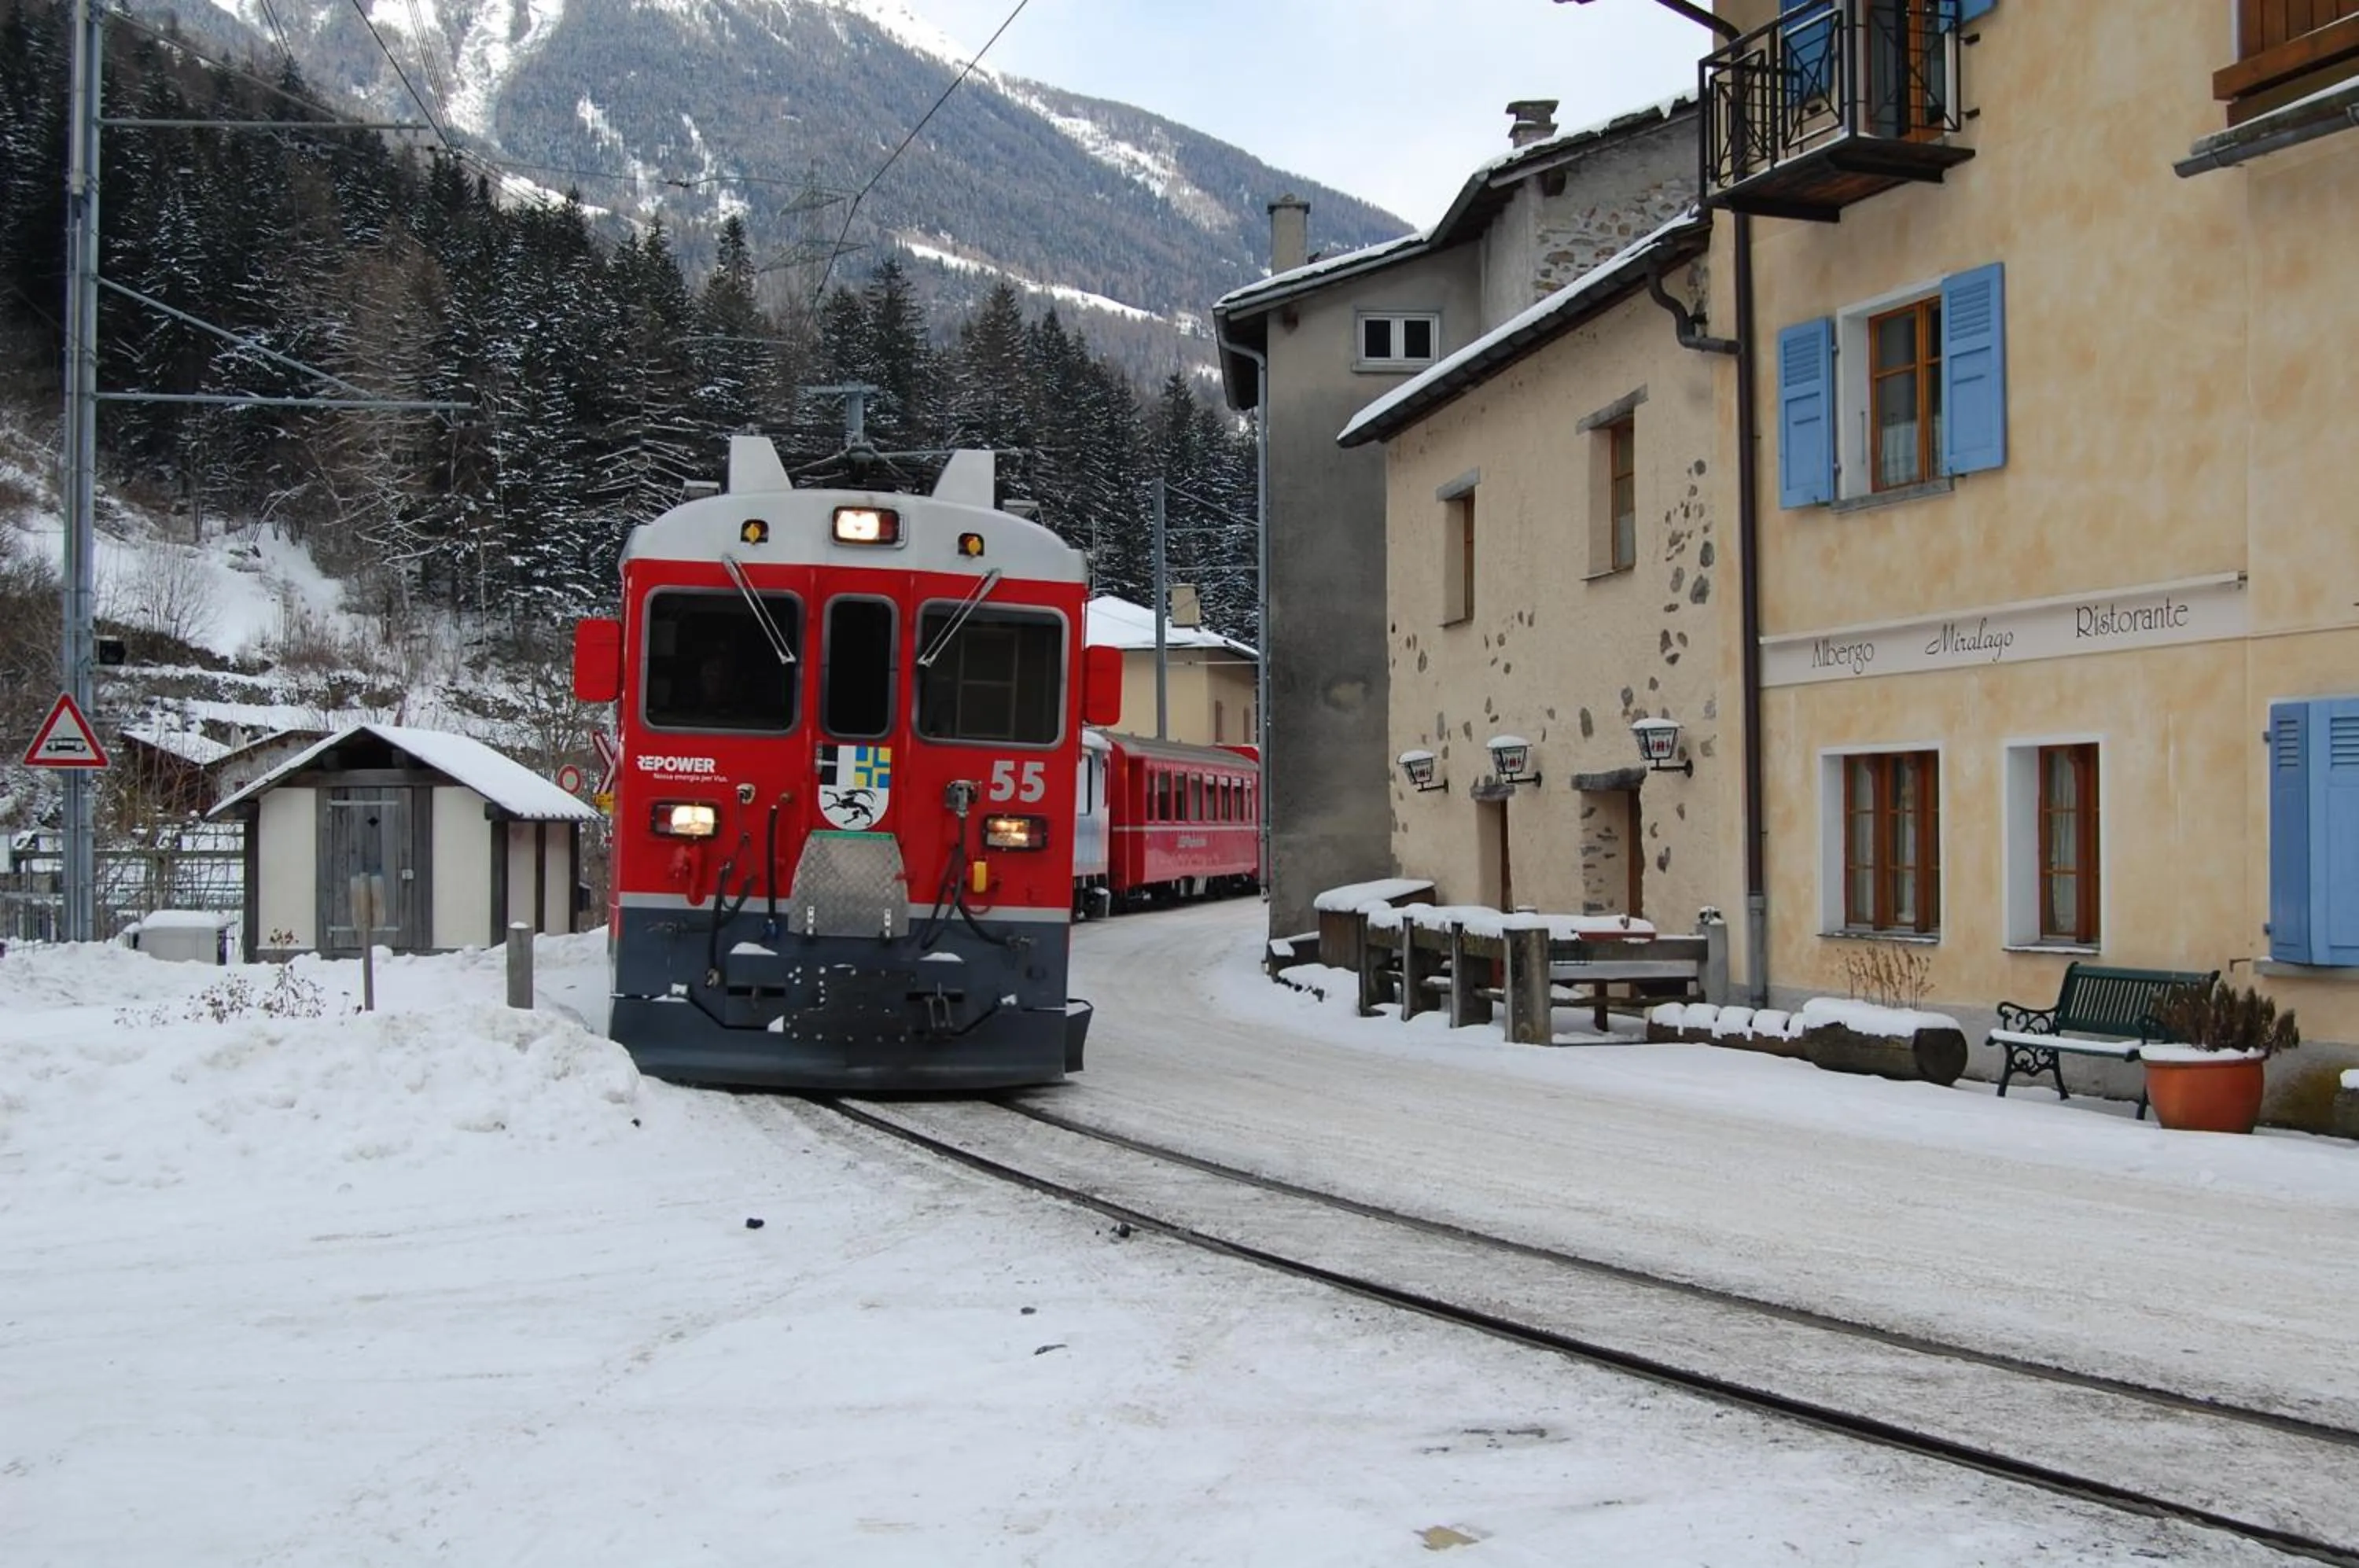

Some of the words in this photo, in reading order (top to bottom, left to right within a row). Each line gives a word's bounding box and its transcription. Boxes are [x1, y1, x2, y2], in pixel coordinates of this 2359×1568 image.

[1812, 639, 1875, 675] Albergo
[1924, 617, 2014, 663] Miralago
[2075, 596, 2189, 638] Ristorante
[636, 755, 716, 773] REPOWER
[989, 760, 1045, 803] 55
